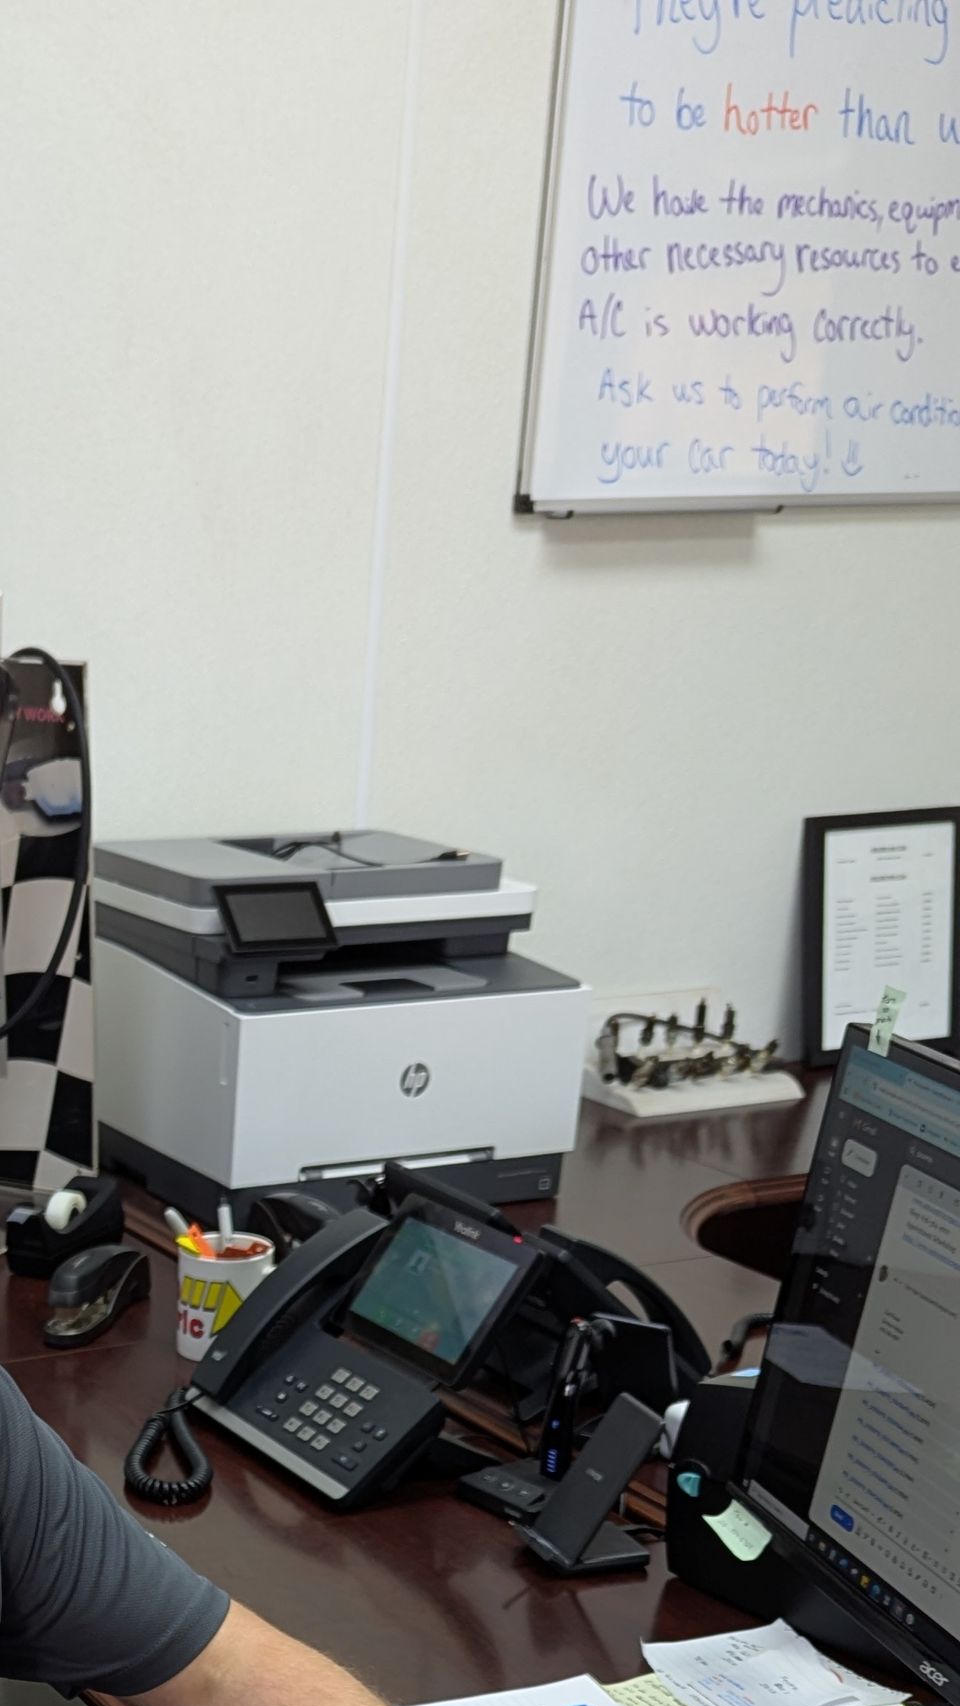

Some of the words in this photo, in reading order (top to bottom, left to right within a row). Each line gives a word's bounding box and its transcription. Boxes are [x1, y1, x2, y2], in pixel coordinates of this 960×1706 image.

[633, 0, 766, 55] Theyre
[619, 82, 656, 128] to
[675, 88, 707, 130] be
[723, 82, 821, 136] hotter
[838, 88, 916, 145] than
[588, 173, 636, 220] We
[652, 175, 710, 218] have
[719, 179, 765, 216] the
[666, 240, 787, 298] necessary
[794, 243, 902, 275] resources
[910, 240, 939, 276] to
[578, 293, 627, 340] A/C
[644, 306, 671, 338] is
[689, 302, 798, 364] working
[597, 367, 655, 408] Ask
[672, 380, 705, 406] us
[719, 373, 742, 410] to
[756, 380, 834, 423] perform
[842, 390, 882, 421] air
[596, 439, 671, 484] your
[919, 1660, 950, 1687] acer
